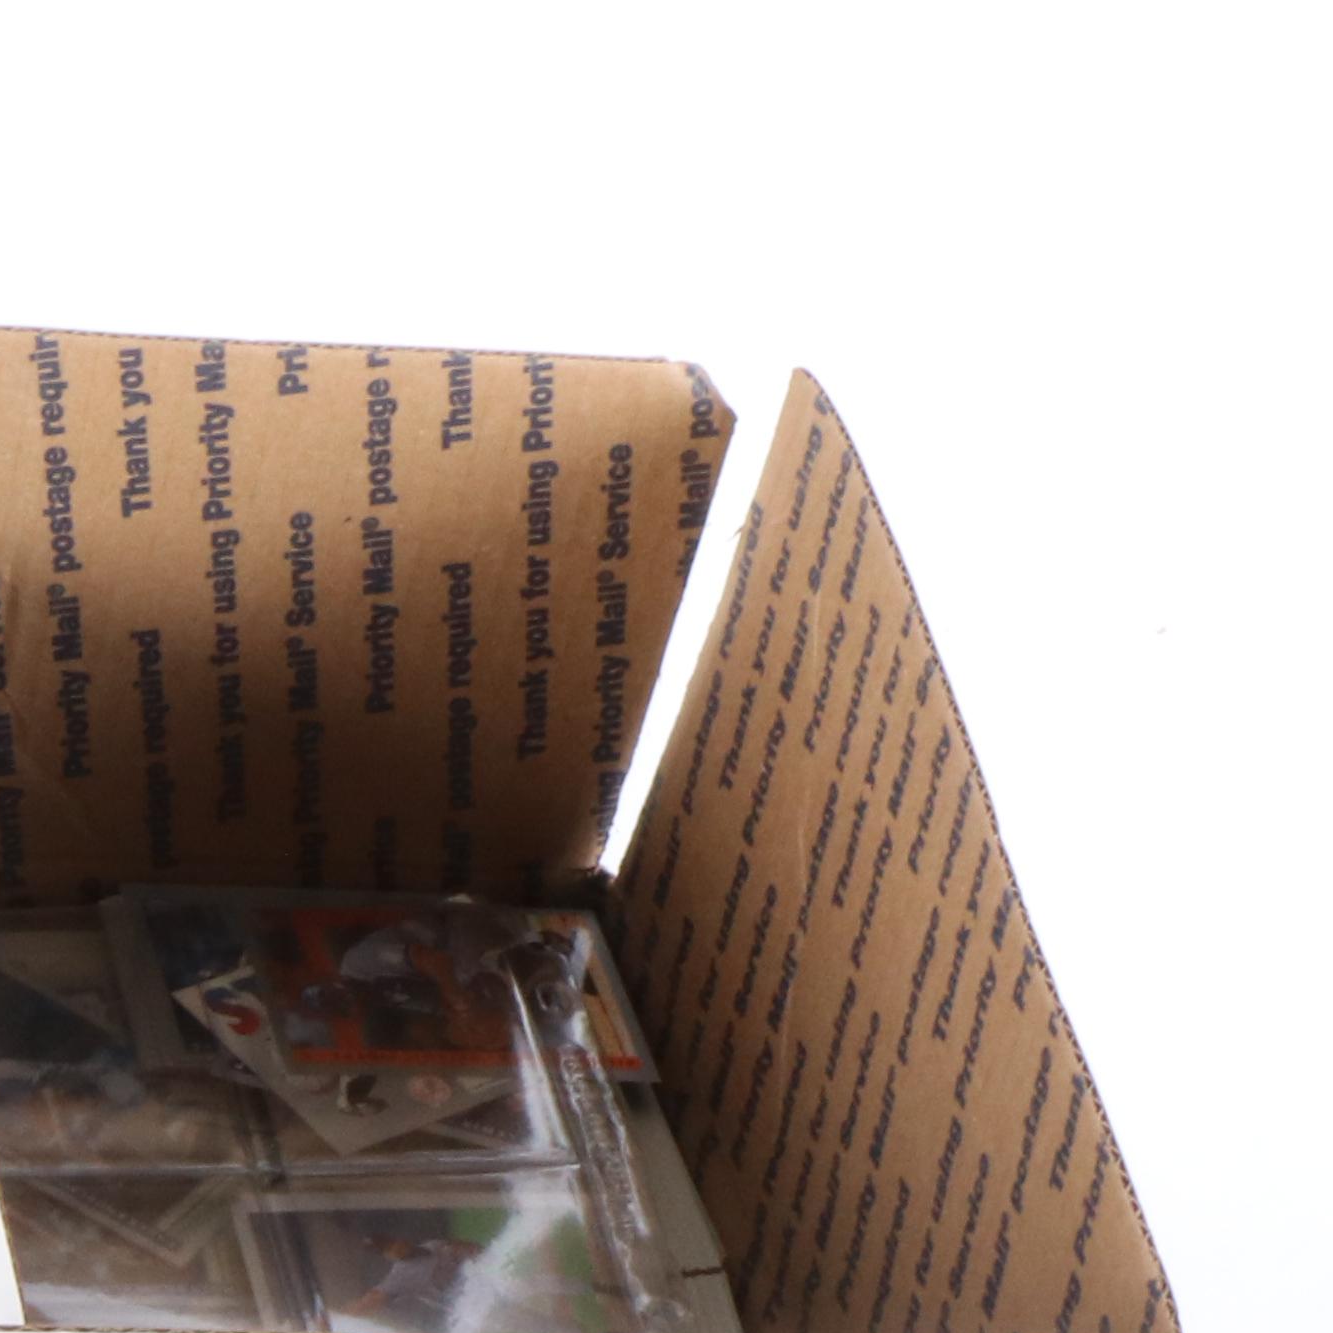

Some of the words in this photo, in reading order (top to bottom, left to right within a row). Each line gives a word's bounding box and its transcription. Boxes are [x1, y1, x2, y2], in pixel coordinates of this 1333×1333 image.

[117, 416, 151, 518] Thank
[200, 402, 236, 522] Priority
[363, 382, 396, 506] postage
[600, 442, 633, 559] Service
[43, 447, 78, 573] postage
[283, 511, 315, 628] Service
[719, 683, 756, 789] Thank
[754, 606, 776, 675] you
[770, 538, 792, 594] for
[788, 424, 822, 532] using
[593, 655, 630, 764] Priority
[836, 604, 880, 772] required
[743, 709, 786, 846] Priority
